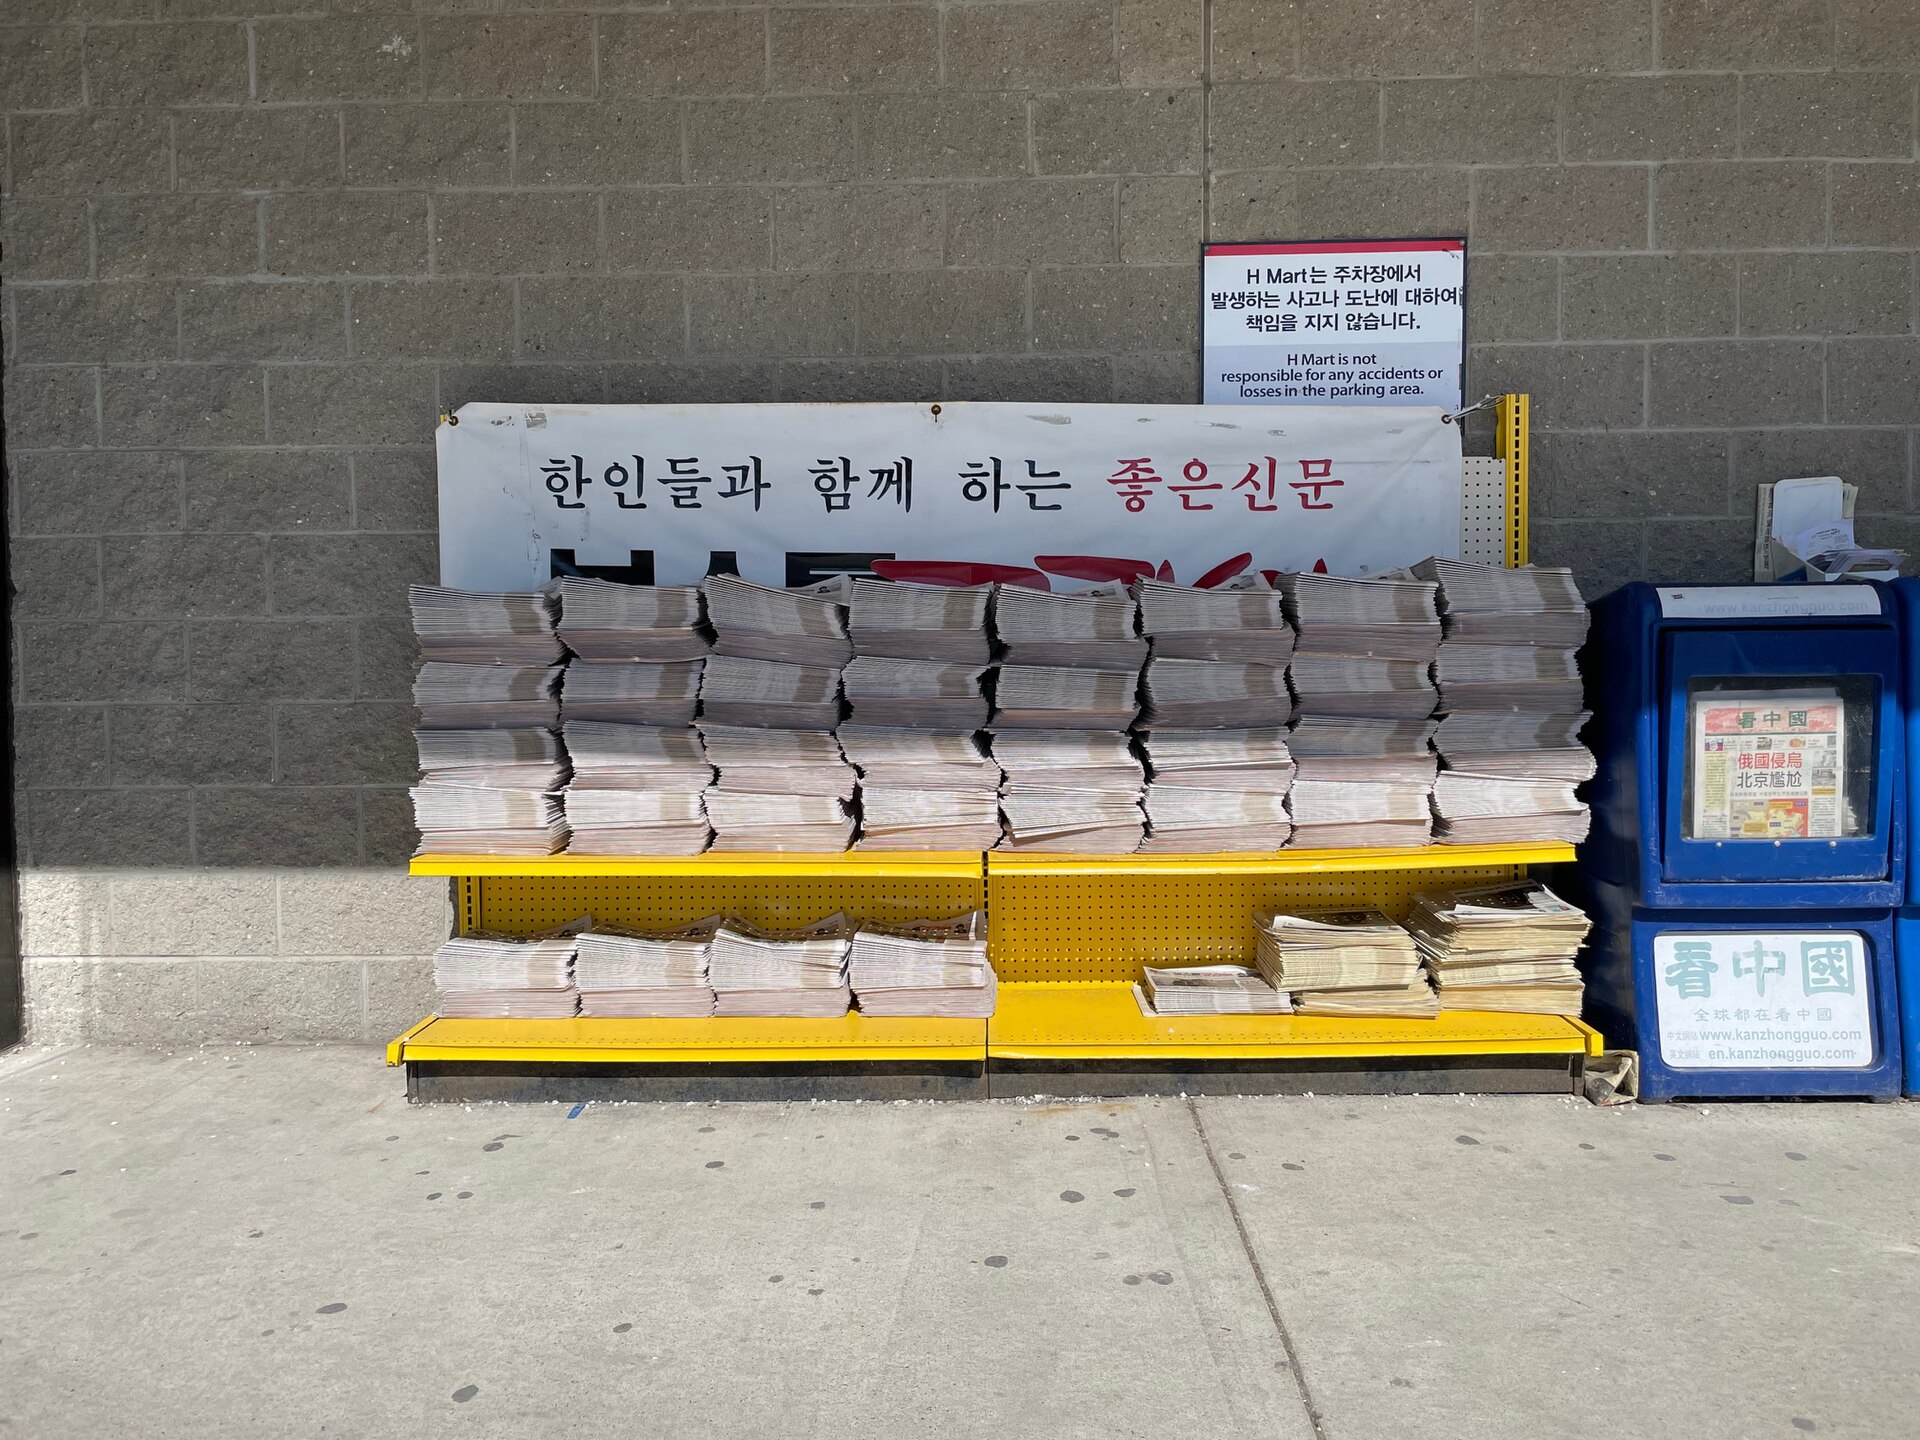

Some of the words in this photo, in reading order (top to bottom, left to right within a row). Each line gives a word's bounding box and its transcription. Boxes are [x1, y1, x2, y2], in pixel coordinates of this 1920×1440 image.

[1247, 269, 1260, 284] H
[1333, 264, 1421, 283] 주차장에서
[1211, 291, 1281, 309] 발생하는
[1287, 289, 1339, 308] 사고나
[1345, 288, 1398, 307] 도난에
[1405, 287, 1458, 306] 대하여
[1246, 313, 1298, 332] 책임을
[1304, 313, 1339, 331] 지지
[1345, 311, 1421, 331] 않습니다.
[1287, 354, 1298, 366] H
[1301, 353, 1335, 366] Mart
[1338, 353, 1349, 365] is
[1353, 354, 1377, 365] not
[1221, 369, 1302, 385] responsible
[1305, 369, 1325, 381] for
[1328, 371, 1354, 384] any
[1358, 367, 1425, 380] accidents
[1427, 369, 1443, 380] or
[1240, 385, 1282, 398] losses
[1284, 385, 1297, 397] in
[1302, 384, 1325, 397] the
[1330, 383, 1385, 399] parking
[1389, 384, 1424, 396] area.
[540, 454, 771, 513] 한인들과
[807, 455, 914, 514] 함께
[957, 456, 1072, 514] 하는
[1106, 455, 1345, 514] 좋은신문
[1739, 710, 1807, 728] 看中國
[1737, 771, 1802, 788] 北京尷尬
[1665, 940, 1856, 1000] 看中國
[1694, 1008, 1832, 1022] 全球都在看中國
[1700, 1028, 1861, 1043] www.kanzhongguo.com
[1709, 1047, 1854, 1062] en.kanzhongguo.com
